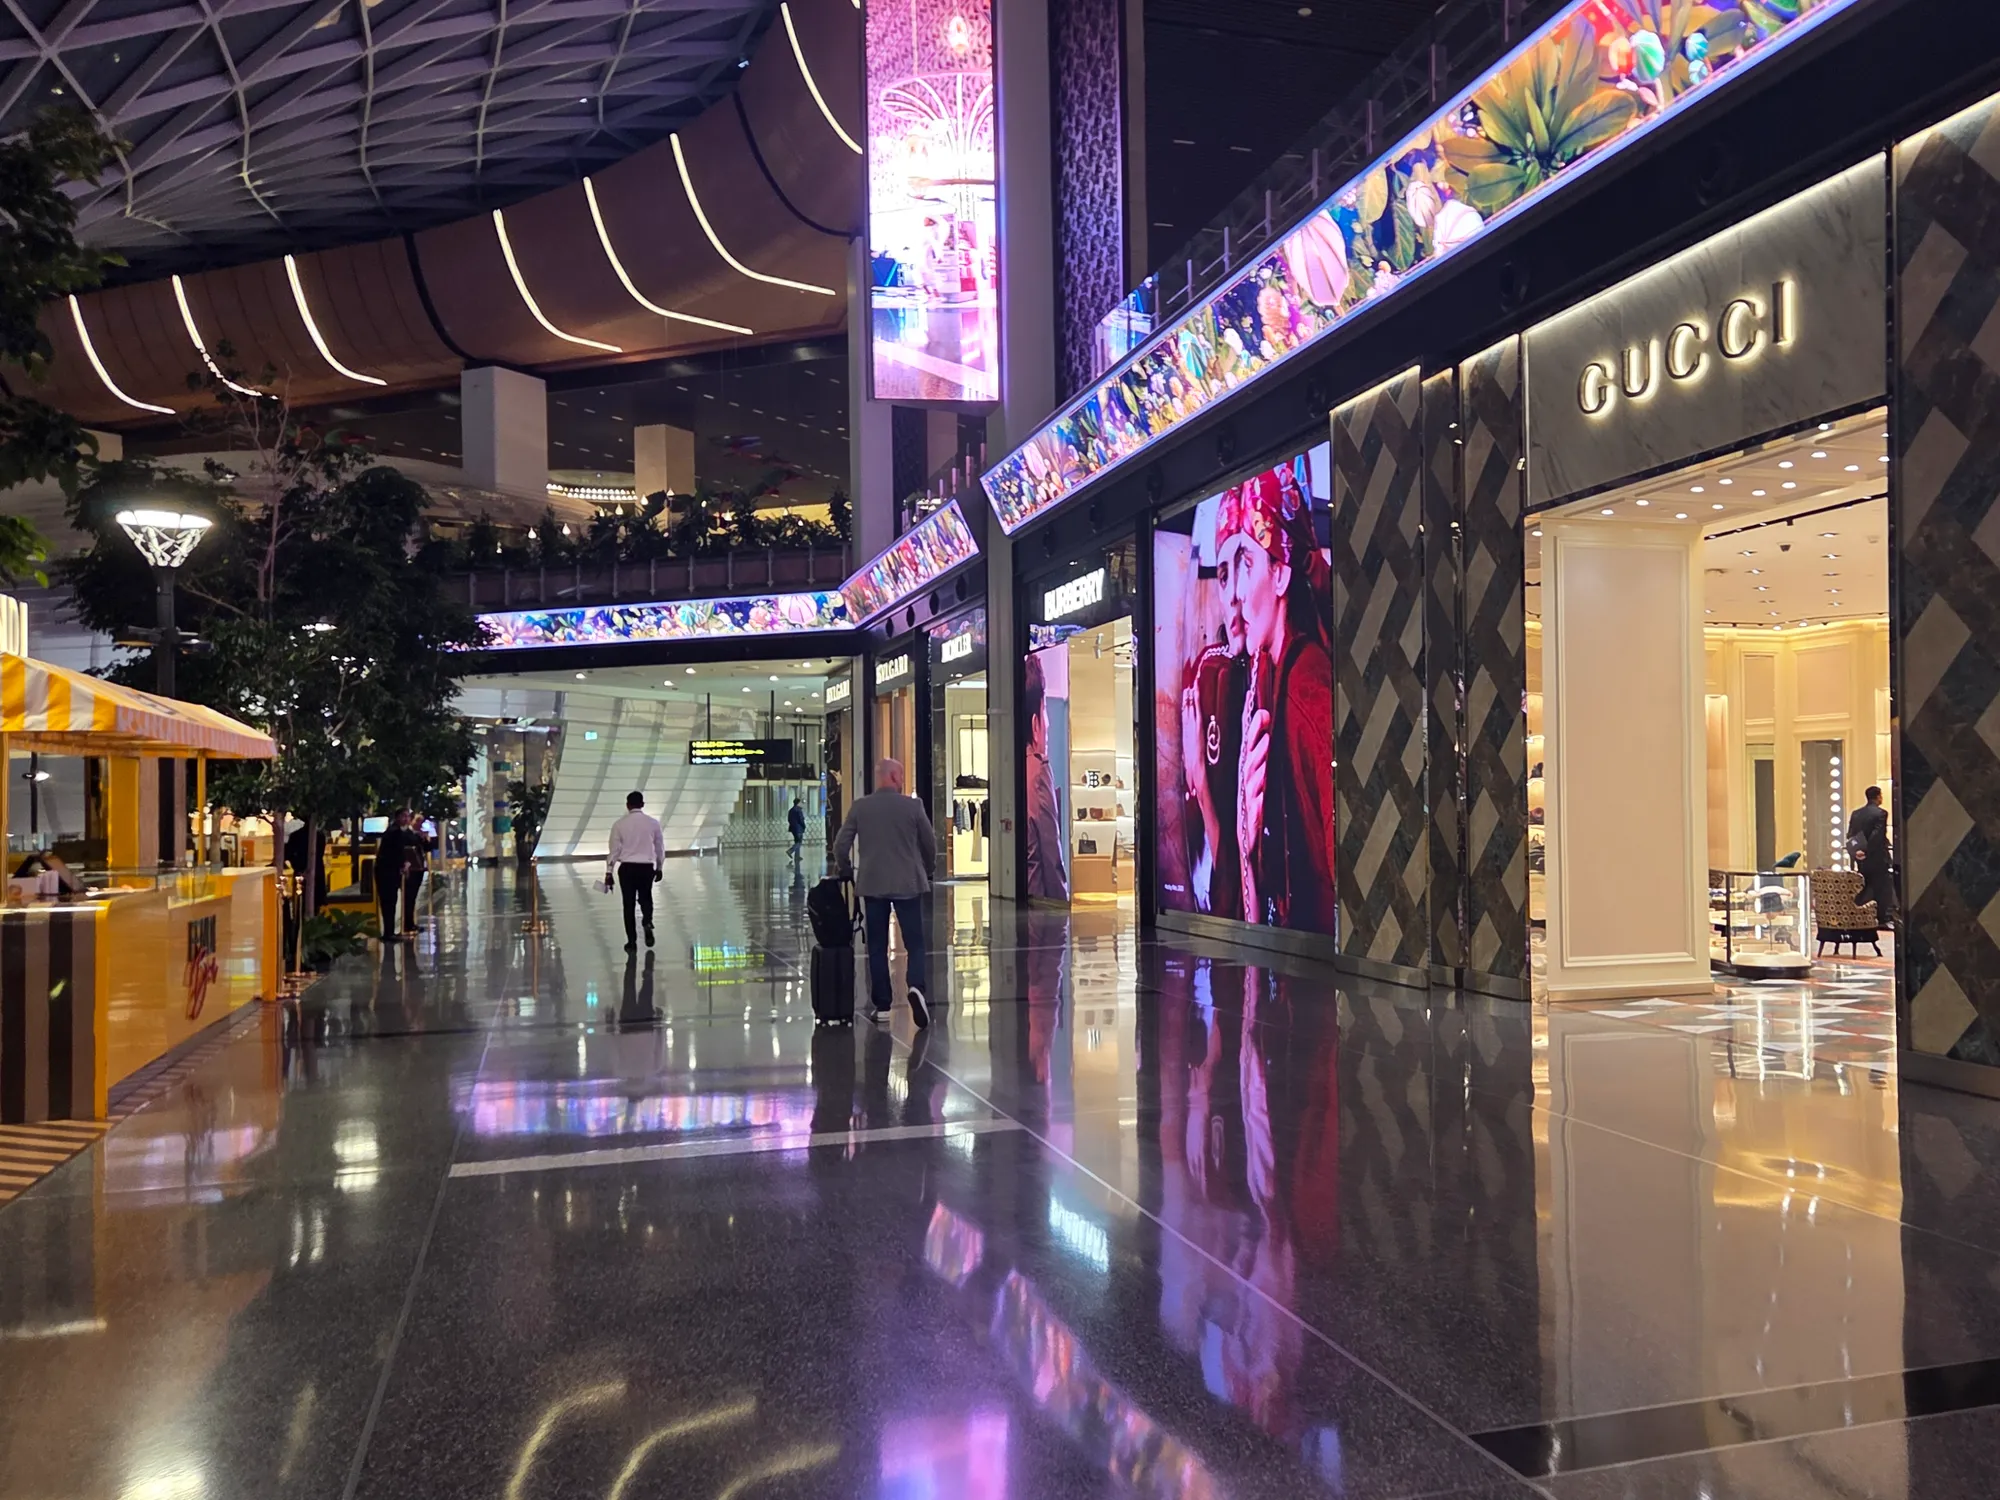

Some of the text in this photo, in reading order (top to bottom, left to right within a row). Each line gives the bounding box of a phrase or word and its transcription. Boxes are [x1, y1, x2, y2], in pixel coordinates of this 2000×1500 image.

[1577, 279, 1795, 417] GUCCI
[1044, 567, 1105, 621] BURBERRY
[876, 653, 908, 685] BVLGARI
